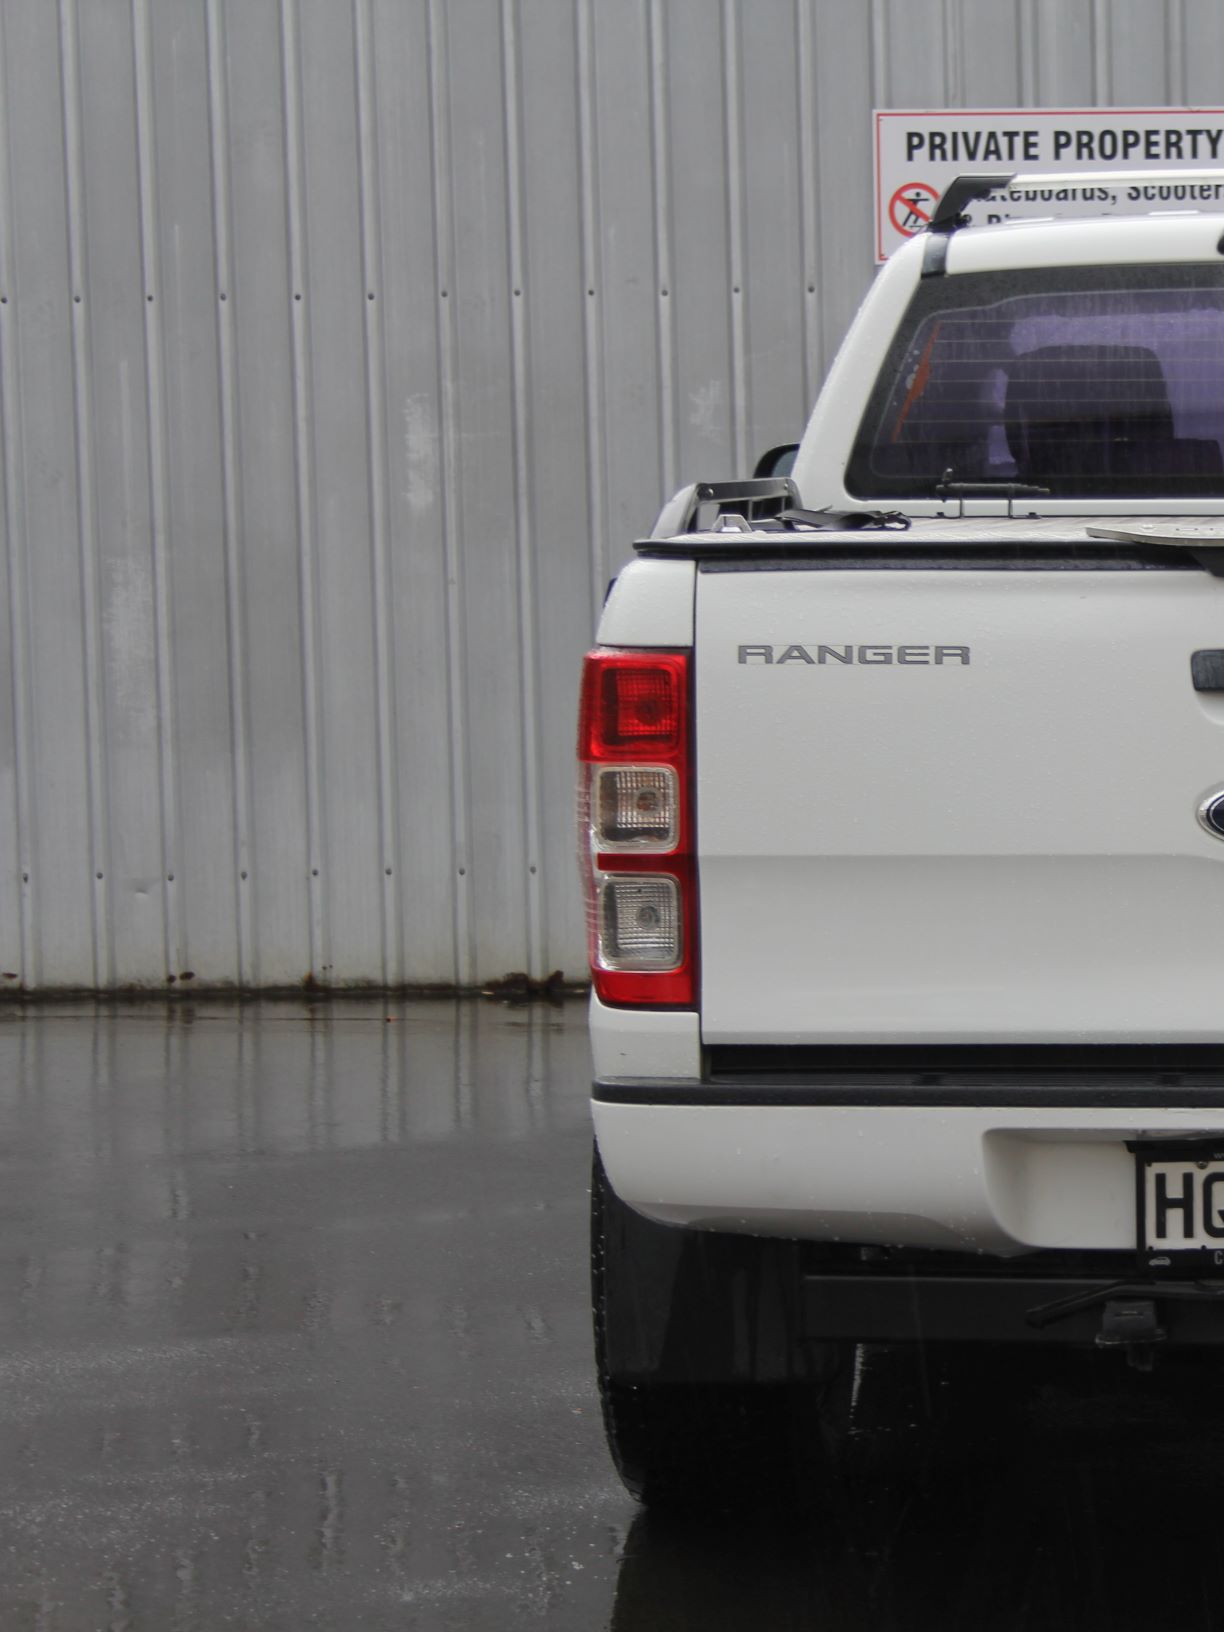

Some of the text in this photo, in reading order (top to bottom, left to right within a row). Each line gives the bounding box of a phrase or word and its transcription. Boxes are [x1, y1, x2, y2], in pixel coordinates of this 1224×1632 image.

[905, 128, 1224, 163] PRIVATE PROPERTY
[737, 645, 971, 665] RANGER
